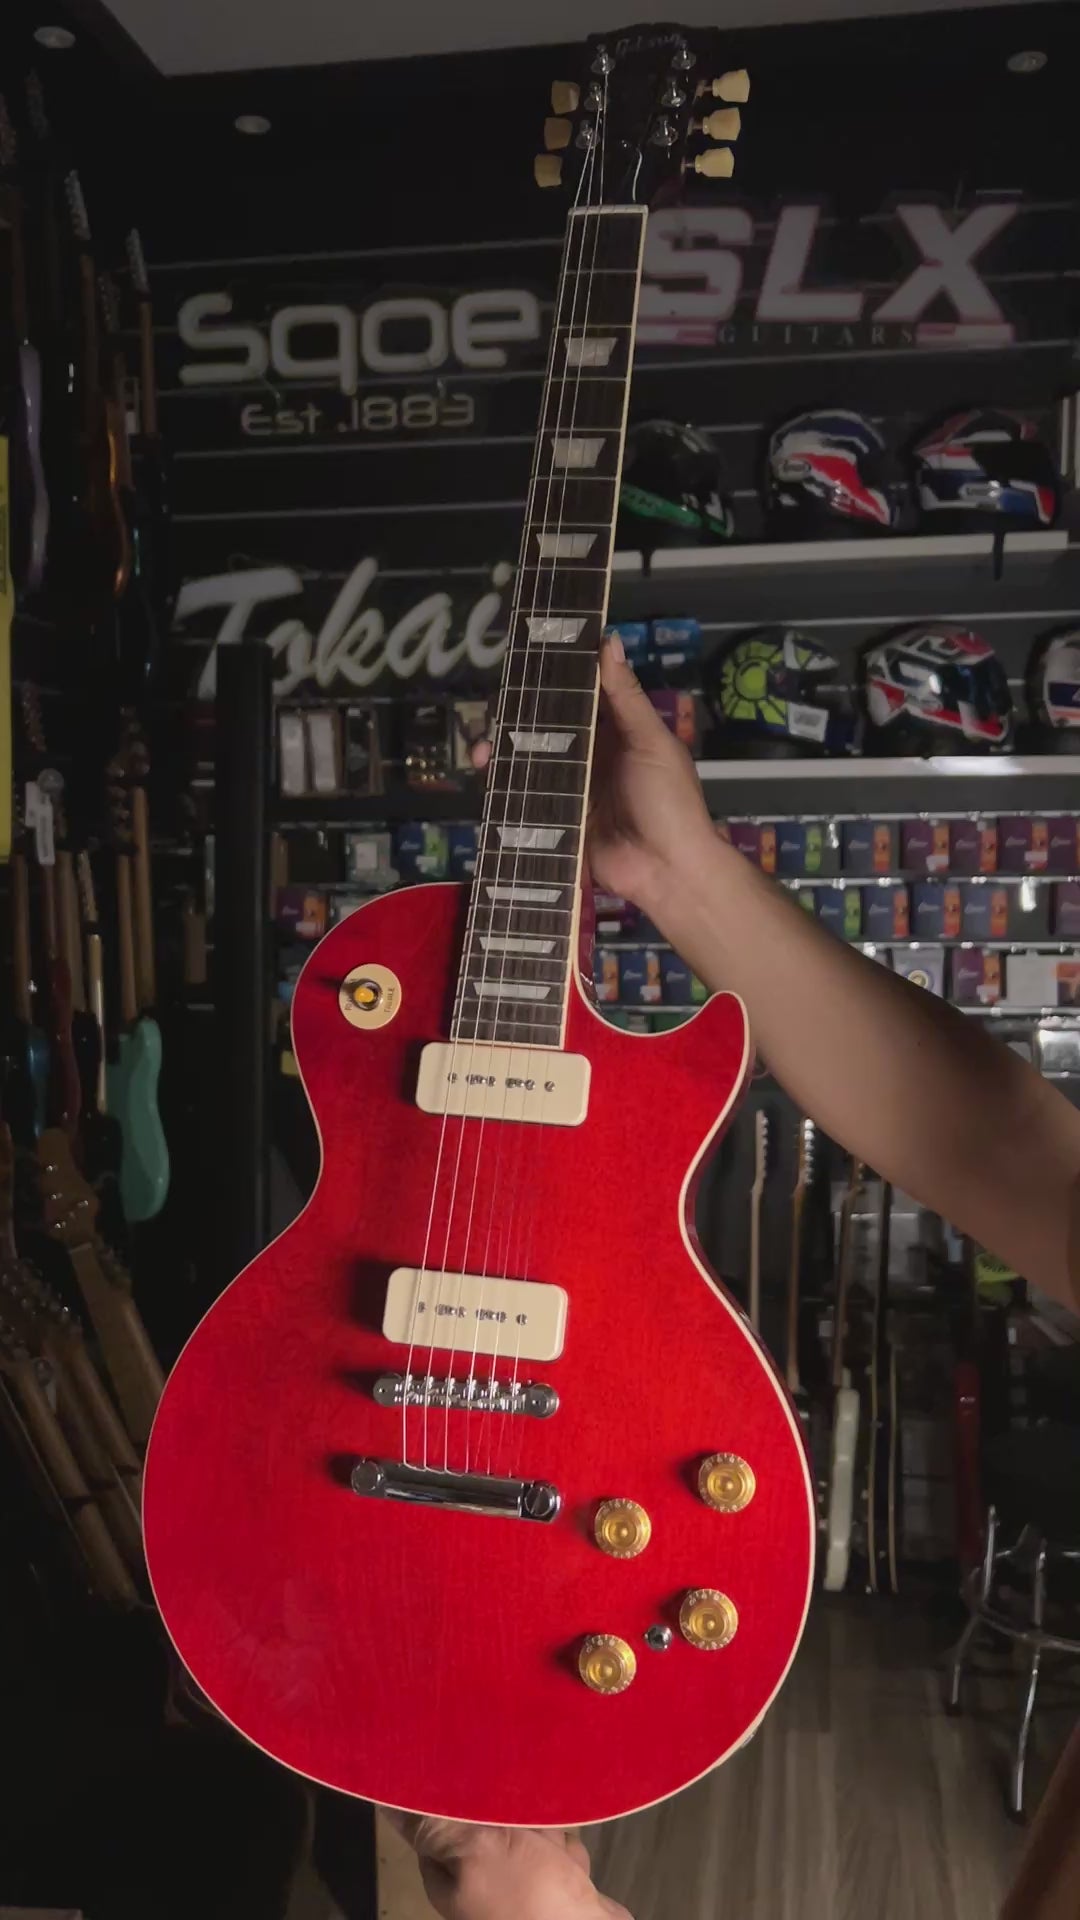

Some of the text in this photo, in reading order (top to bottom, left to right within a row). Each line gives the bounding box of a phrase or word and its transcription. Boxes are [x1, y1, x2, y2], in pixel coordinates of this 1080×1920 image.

[639, 203, 1018, 323] SLX
[240, 402, 322, 436] Est
[172, 556, 512, 700] Tokai
